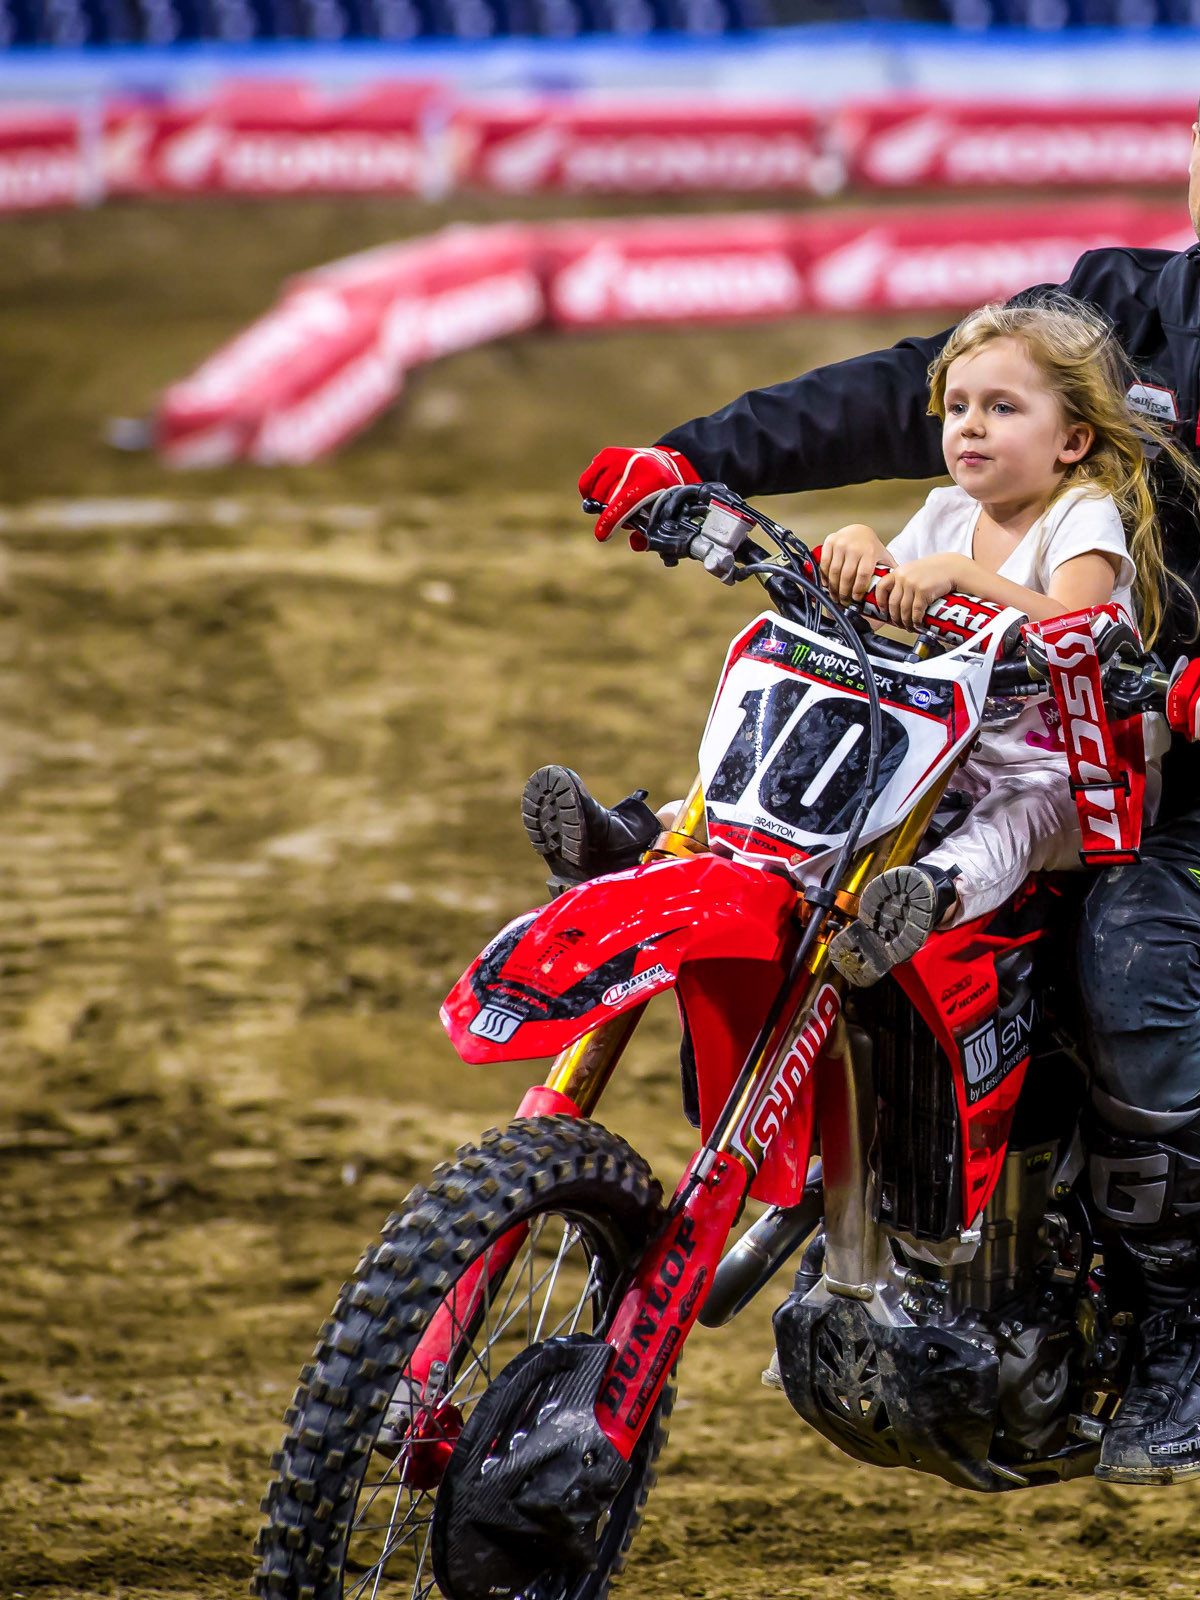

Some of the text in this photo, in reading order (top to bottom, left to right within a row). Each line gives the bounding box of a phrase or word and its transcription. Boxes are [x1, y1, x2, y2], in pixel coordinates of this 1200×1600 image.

[807, 650, 894, 692] MONSER
[814, 667, 866, 691] ENERG
[705, 677, 910, 836] 10
[1060, 671, 1123, 851] SCOTT
[753, 815, 796, 840] BRAYTON
[620, 964, 665, 994] MAXIMA
[500, 985, 549, 1013] HONDA
[956, 981, 992, 1011] HONDA
[750, 983, 842, 1155] SHOWA
[970, 1087, 981, 1102] by
[600, 1215, 697, 1419] DUNLOP
